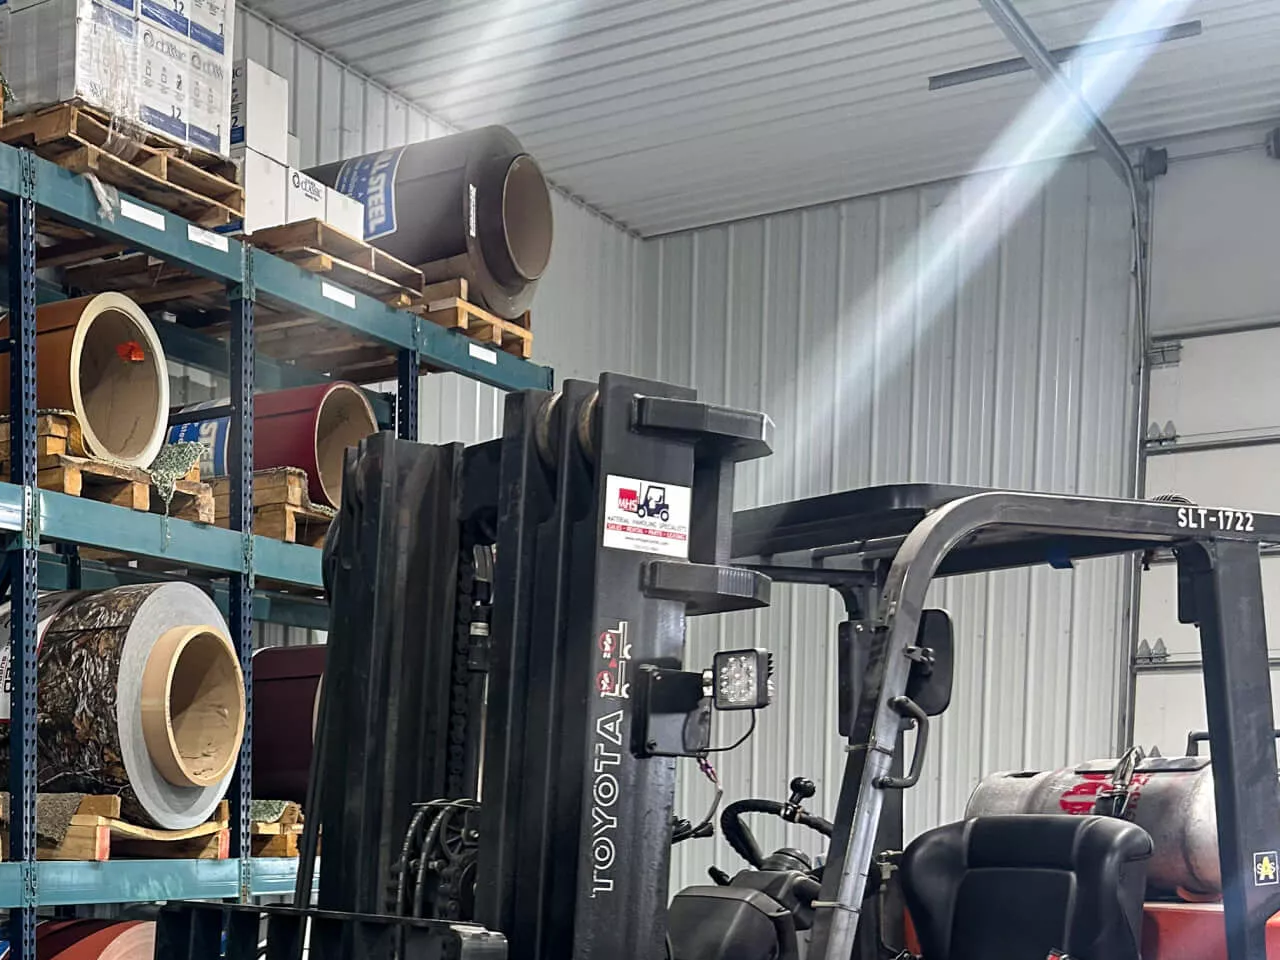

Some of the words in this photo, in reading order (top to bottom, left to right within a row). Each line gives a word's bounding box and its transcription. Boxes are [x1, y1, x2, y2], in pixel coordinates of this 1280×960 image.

[367, 172, 387, 234] STEEL
[618, 498, 638, 512] MHS
[1177, 507, 1255, 532] SLT-1722
[588, 709, 624, 898] TOYOTA
